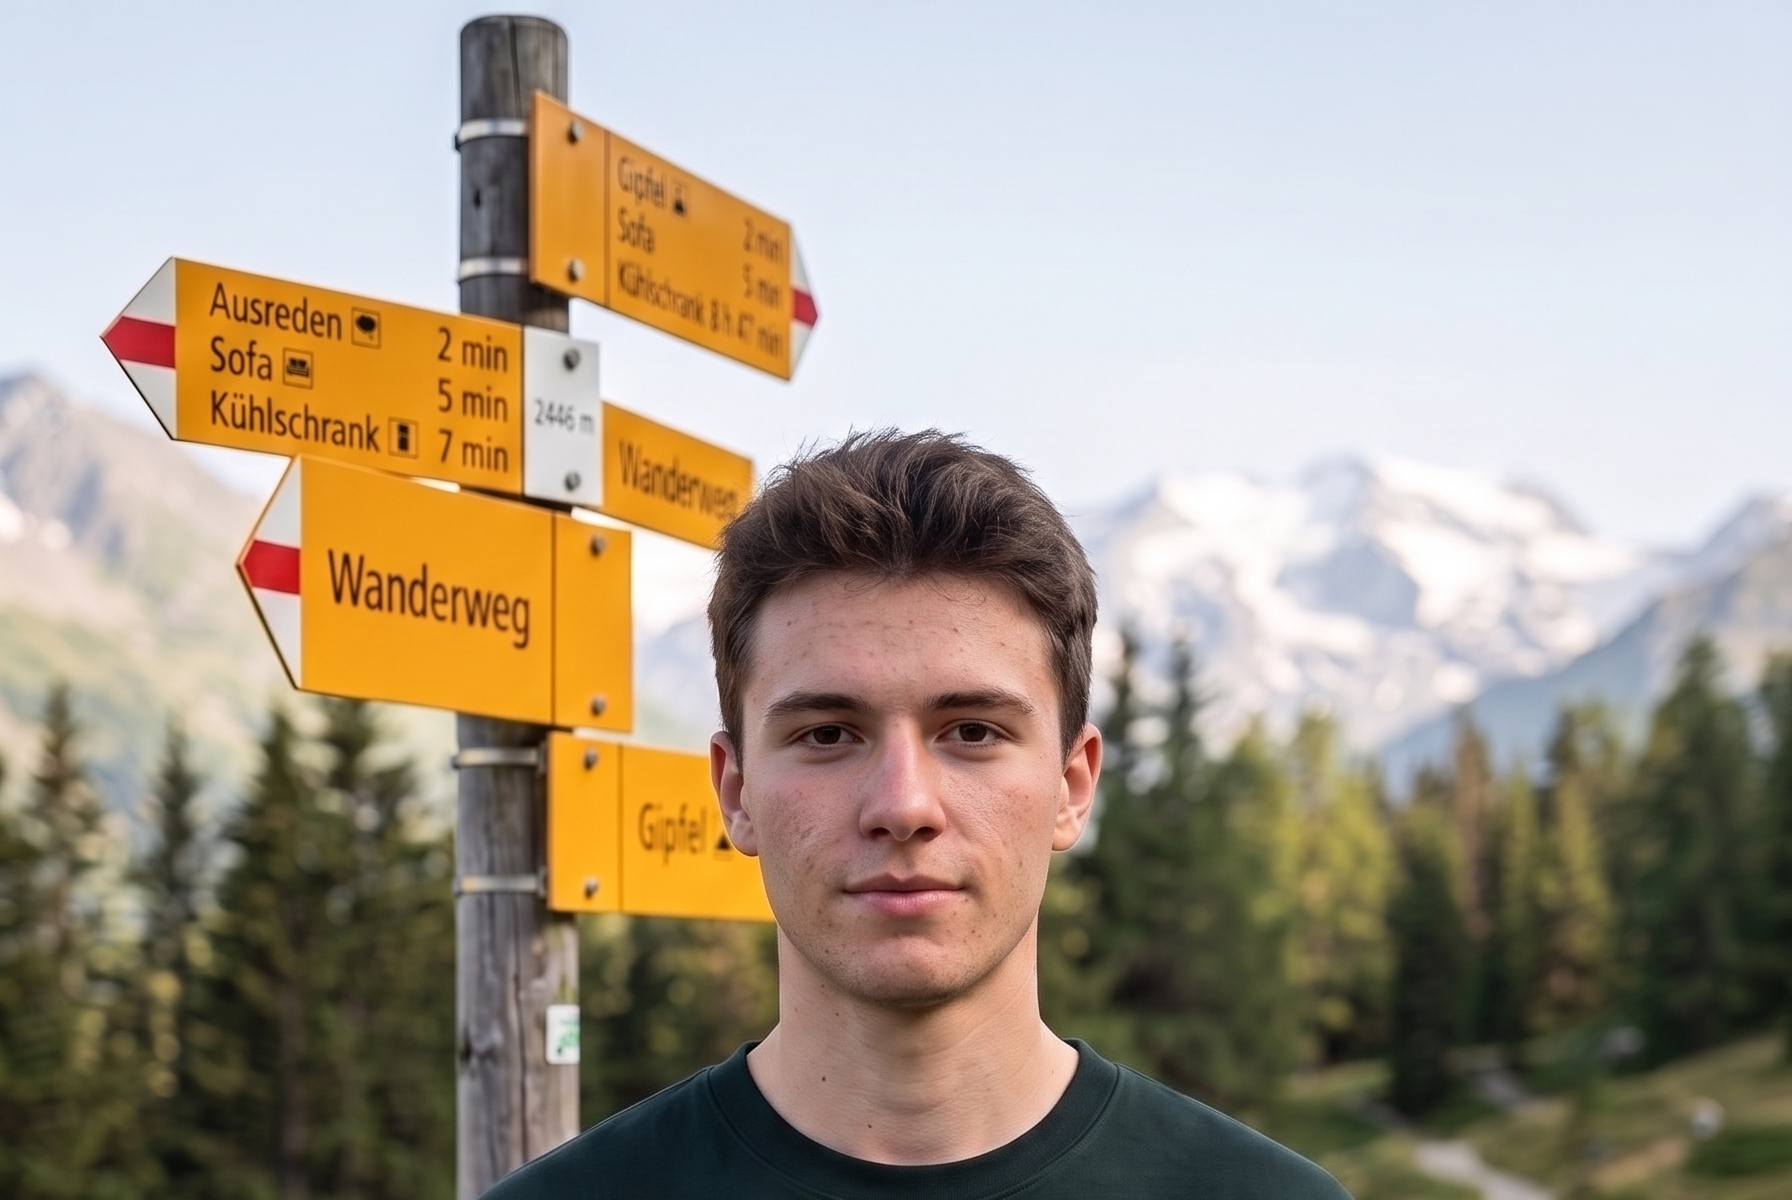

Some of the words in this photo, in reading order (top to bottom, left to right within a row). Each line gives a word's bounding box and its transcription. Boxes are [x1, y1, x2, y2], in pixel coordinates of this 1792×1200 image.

[617, 156, 666, 208] Gipfel
[743, 217, 753, 252] 2
[757, 231, 780, 262] min
[617, 206, 655, 255] Sofa
[757, 278, 780, 309] min
[209, 282, 342, 341] Ausreden
[438, 326, 452, 362] 2
[461, 335, 508, 373] min
[618, 259, 704, 326] Kühlschrank
[757, 326, 780, 356] min
[210, 335, 273, 381] Sofa
[437, 378, 453, 413] 5
[461, 386, 508, 423] min
[534, 399, 574, 432] 2446
[579, 415, 594, 434] m
[210, 390, 380, 452] Kühlschrank
[437, 429, 453, 463] 7
[461, 436, 508, 473] min
[328, 548, 531, 650] Wanderweg
[638, 802, 707, 866] Gipfel
